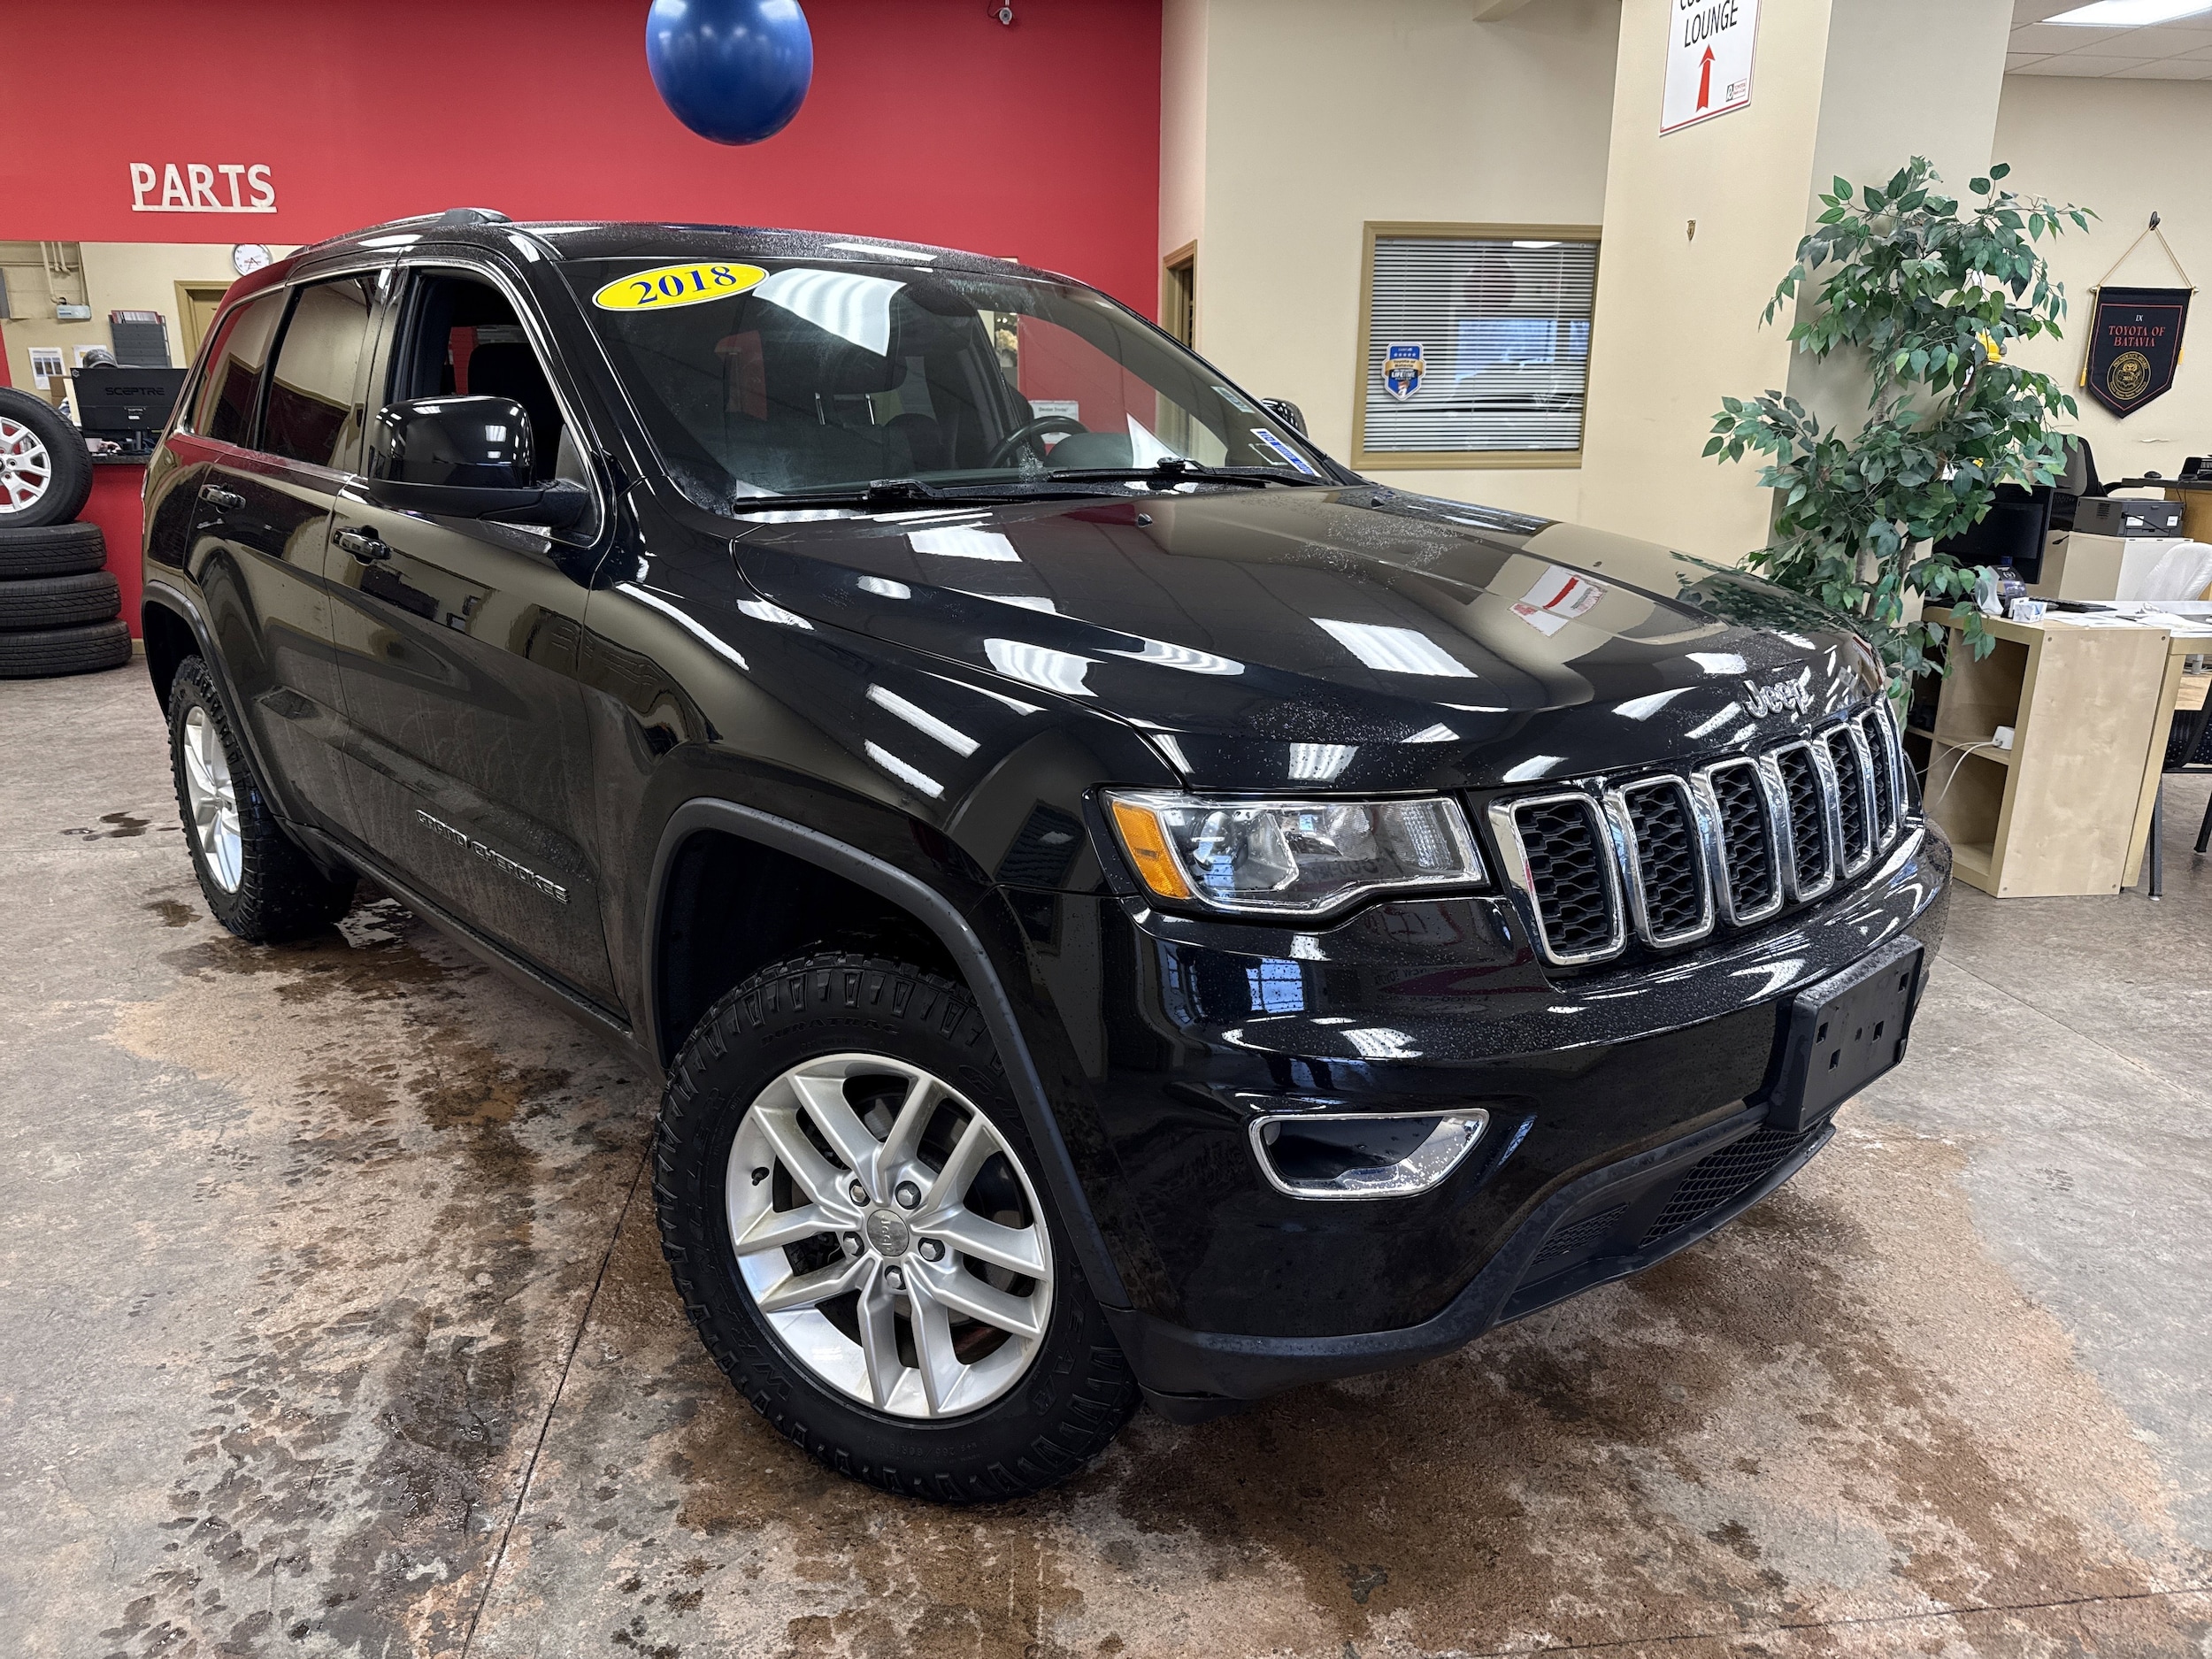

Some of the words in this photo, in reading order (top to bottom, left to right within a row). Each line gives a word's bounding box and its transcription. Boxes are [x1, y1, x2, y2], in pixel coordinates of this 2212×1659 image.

[1684, 0, 1739, 48] LOUNGE
[129, 162, 277, 210] PARTS
[629, 265, 737, 305] 2018
[2108, 326, 2147, 336] TOYOTA
[2151, 326, 2166, 336] OF
[2114, 337, 2155, 347] BATAVIA
[105, 387, 166, 396] SCEPTRE
[1742, 679, 1809, 719] Jeep
[415, 809, 472, 849] GRAND
[472, 841, 569, 904] CHEROKEE
[760, 1016, 901, 1048] DURATRAC
